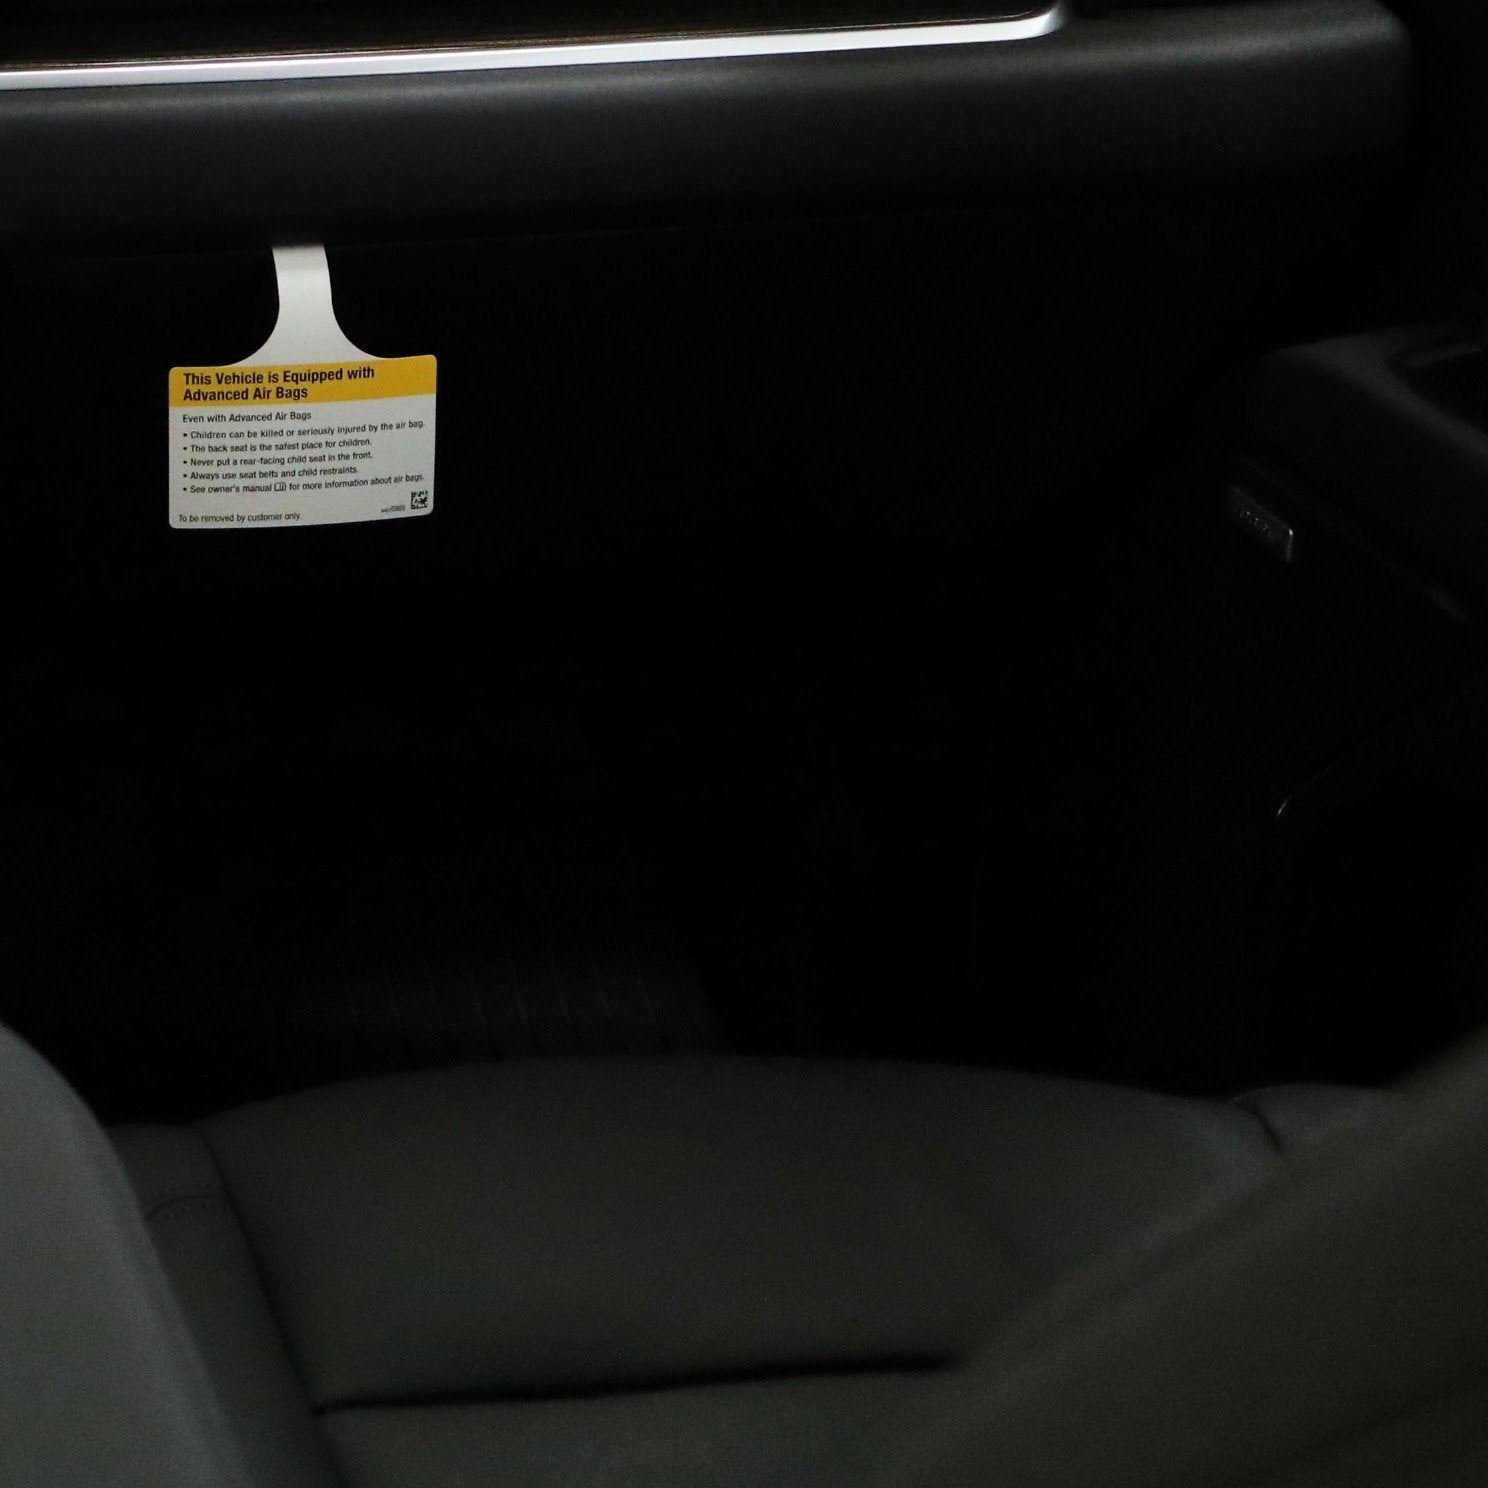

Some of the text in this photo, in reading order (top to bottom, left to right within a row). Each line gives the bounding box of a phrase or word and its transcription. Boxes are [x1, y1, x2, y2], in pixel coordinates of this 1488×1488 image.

[183, 366, 375, 385] This Vehicle is Equipped with
[183, 386, 308, 401] Advanced Air Bags
[182, 411, 312, 423] Even with Advanced Air Bags
[190, 430, 226, 439] Children
[229, 431, 245, 439] can
[247, 429, 258, 438] be
[260, 428, 284, 438] killed
[286, 429, 295, 437] or
[297, 426, 335, 437] seriously
[337, 424, 366, 434] injured
[368, 423, 379, 433] by
[380, 422, 394, 431] the
[395, 420, 406, 429] air
[190, 444, 205, 453] The
[208, 443, 228, 452] back
[230, 443, 248, 452] seat
[259, 442, 273, 451] the
[274, 441, 299, 450] safest
[301, 440, 323, 450] place
[325, 439, 336, 448] for
[338, 437, 372, 447] children.
[190, 458, 214, 466] Never
[217, 457, 230, 467] put
[240, 456, 285, 466] rear-facing
[287, 455, 307, 464] child
[309, 454, 326, 462] seat
[338, 452, 350, 461] the
[352, 451, 373, 460] front.
[190, 472, 219, 481] Always
[222, 472, 236, 480] use
[239, 471, 257, 479] seat
[259, 470, 278, 478] belts
[281, 469, 295, 478] and
[298, 467, 317, 476] child
[190, 485, 205, 493] See
[208, 484, 240, 493] owner's
[242, 483, 272, 492] manual
[289, 482, 300, 490] for
[302, 482, 322, 490] more
[324, 479, 368, 489] information
[370, 476, 392, 485] about
[393, 475, 404, 483] air
[179, 514, 187, 522] To
[189, 514, 199, 522] be
[201, 513, 235, 522] removed
[237, 513, 246, 523] by
[247, 512, 282, 522] customer
